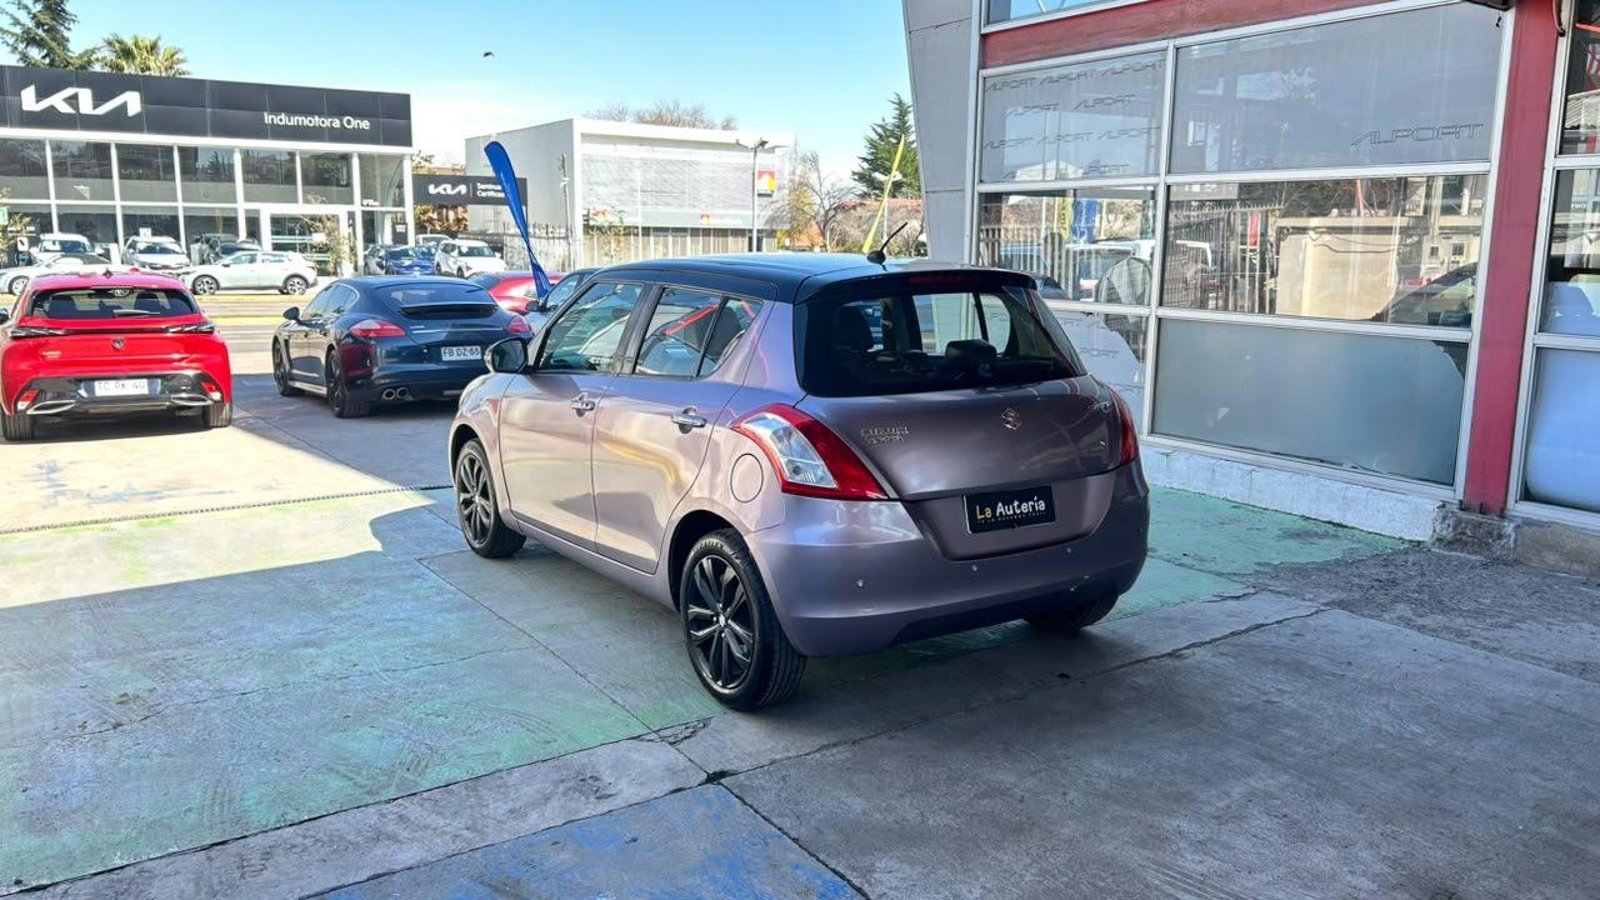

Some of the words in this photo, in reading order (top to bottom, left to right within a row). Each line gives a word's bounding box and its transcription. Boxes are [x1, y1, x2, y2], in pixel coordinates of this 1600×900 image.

[20, 84, 141, 117] KIA
[264, 112, 340, 128] Indumotora
[343, 116, 370, 130] One
[428, 183, 467, 195] KIA
[976, 505, 992, 519] La
[996, 496, 1046, 517] Autería
